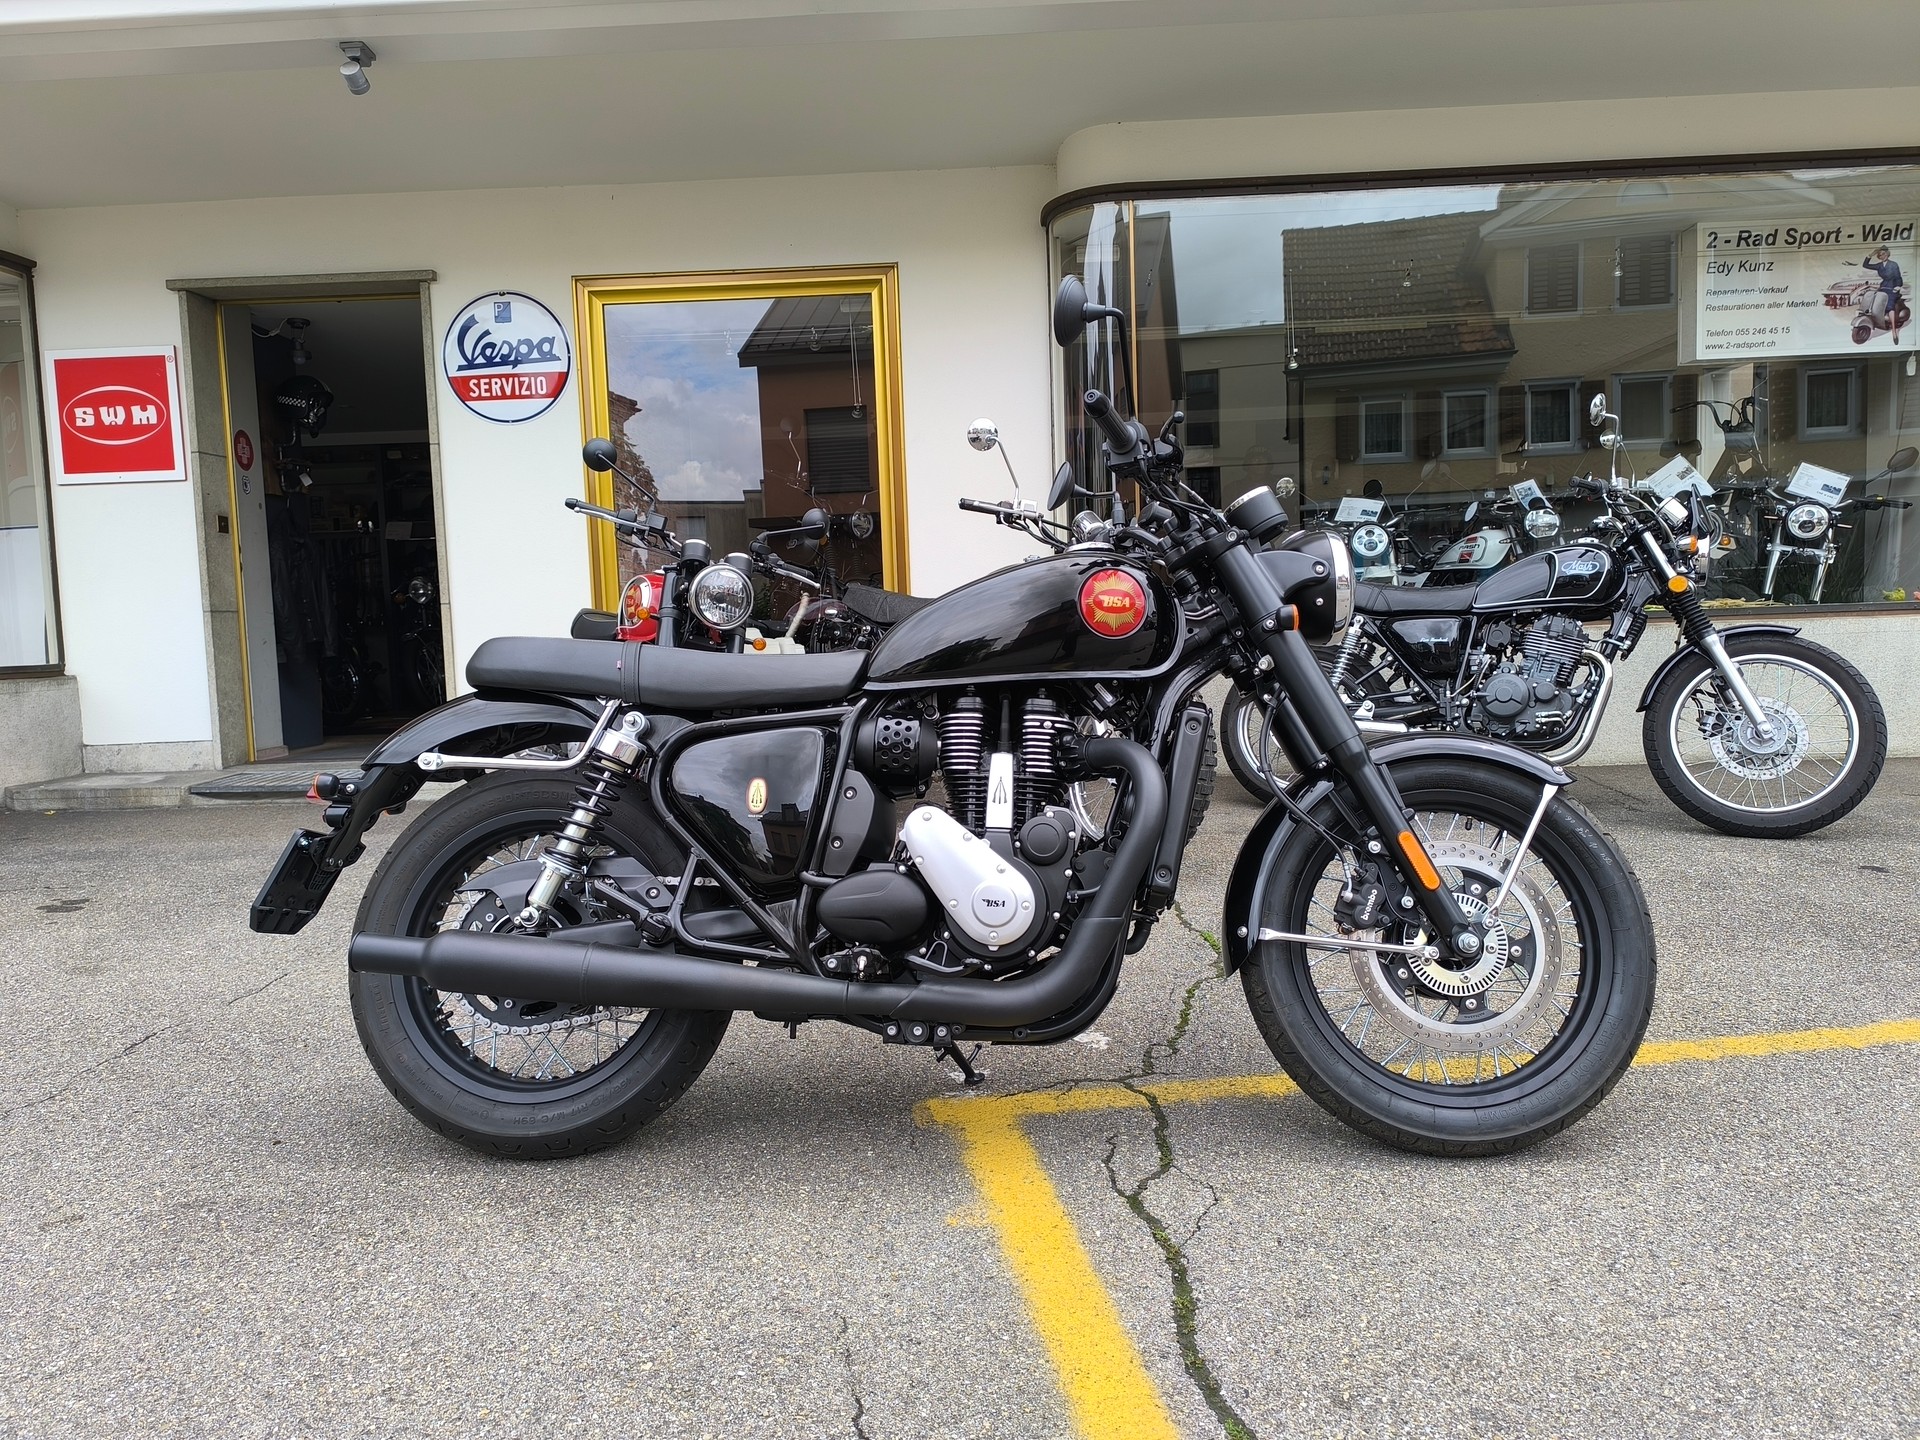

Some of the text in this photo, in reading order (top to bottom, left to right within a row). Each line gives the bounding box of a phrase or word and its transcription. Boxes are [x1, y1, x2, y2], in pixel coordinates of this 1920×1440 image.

[1706, 231, 1718, 249] 2
[1736, 228, 1779, 248] Rad
[1784, 227, 1842, 249] Sport
[1862, 222, 1914, 242] Wald
[1706, 259, 1775, 277] Edy Kunz
[1705, 285, 1789, 298] Reparaturen-Verkauf
[1705, 299, 1819, 312] Restaurationen aller Marken!
[1705, 326, 1791, 338] Telefon 055 246 45 15
[456, 313, 562, 372] Vespa
[1705, 339, 1776, 350] www.2-radsport.ch
[469, 376, 547, 398] SERVIZIO
[74, 404, 158, 427] SWM
[1098, 594, 1130, 608] BSA
[981, 898, 1006, 908] BSA
[1360, 889, 1378, 921] brembo
